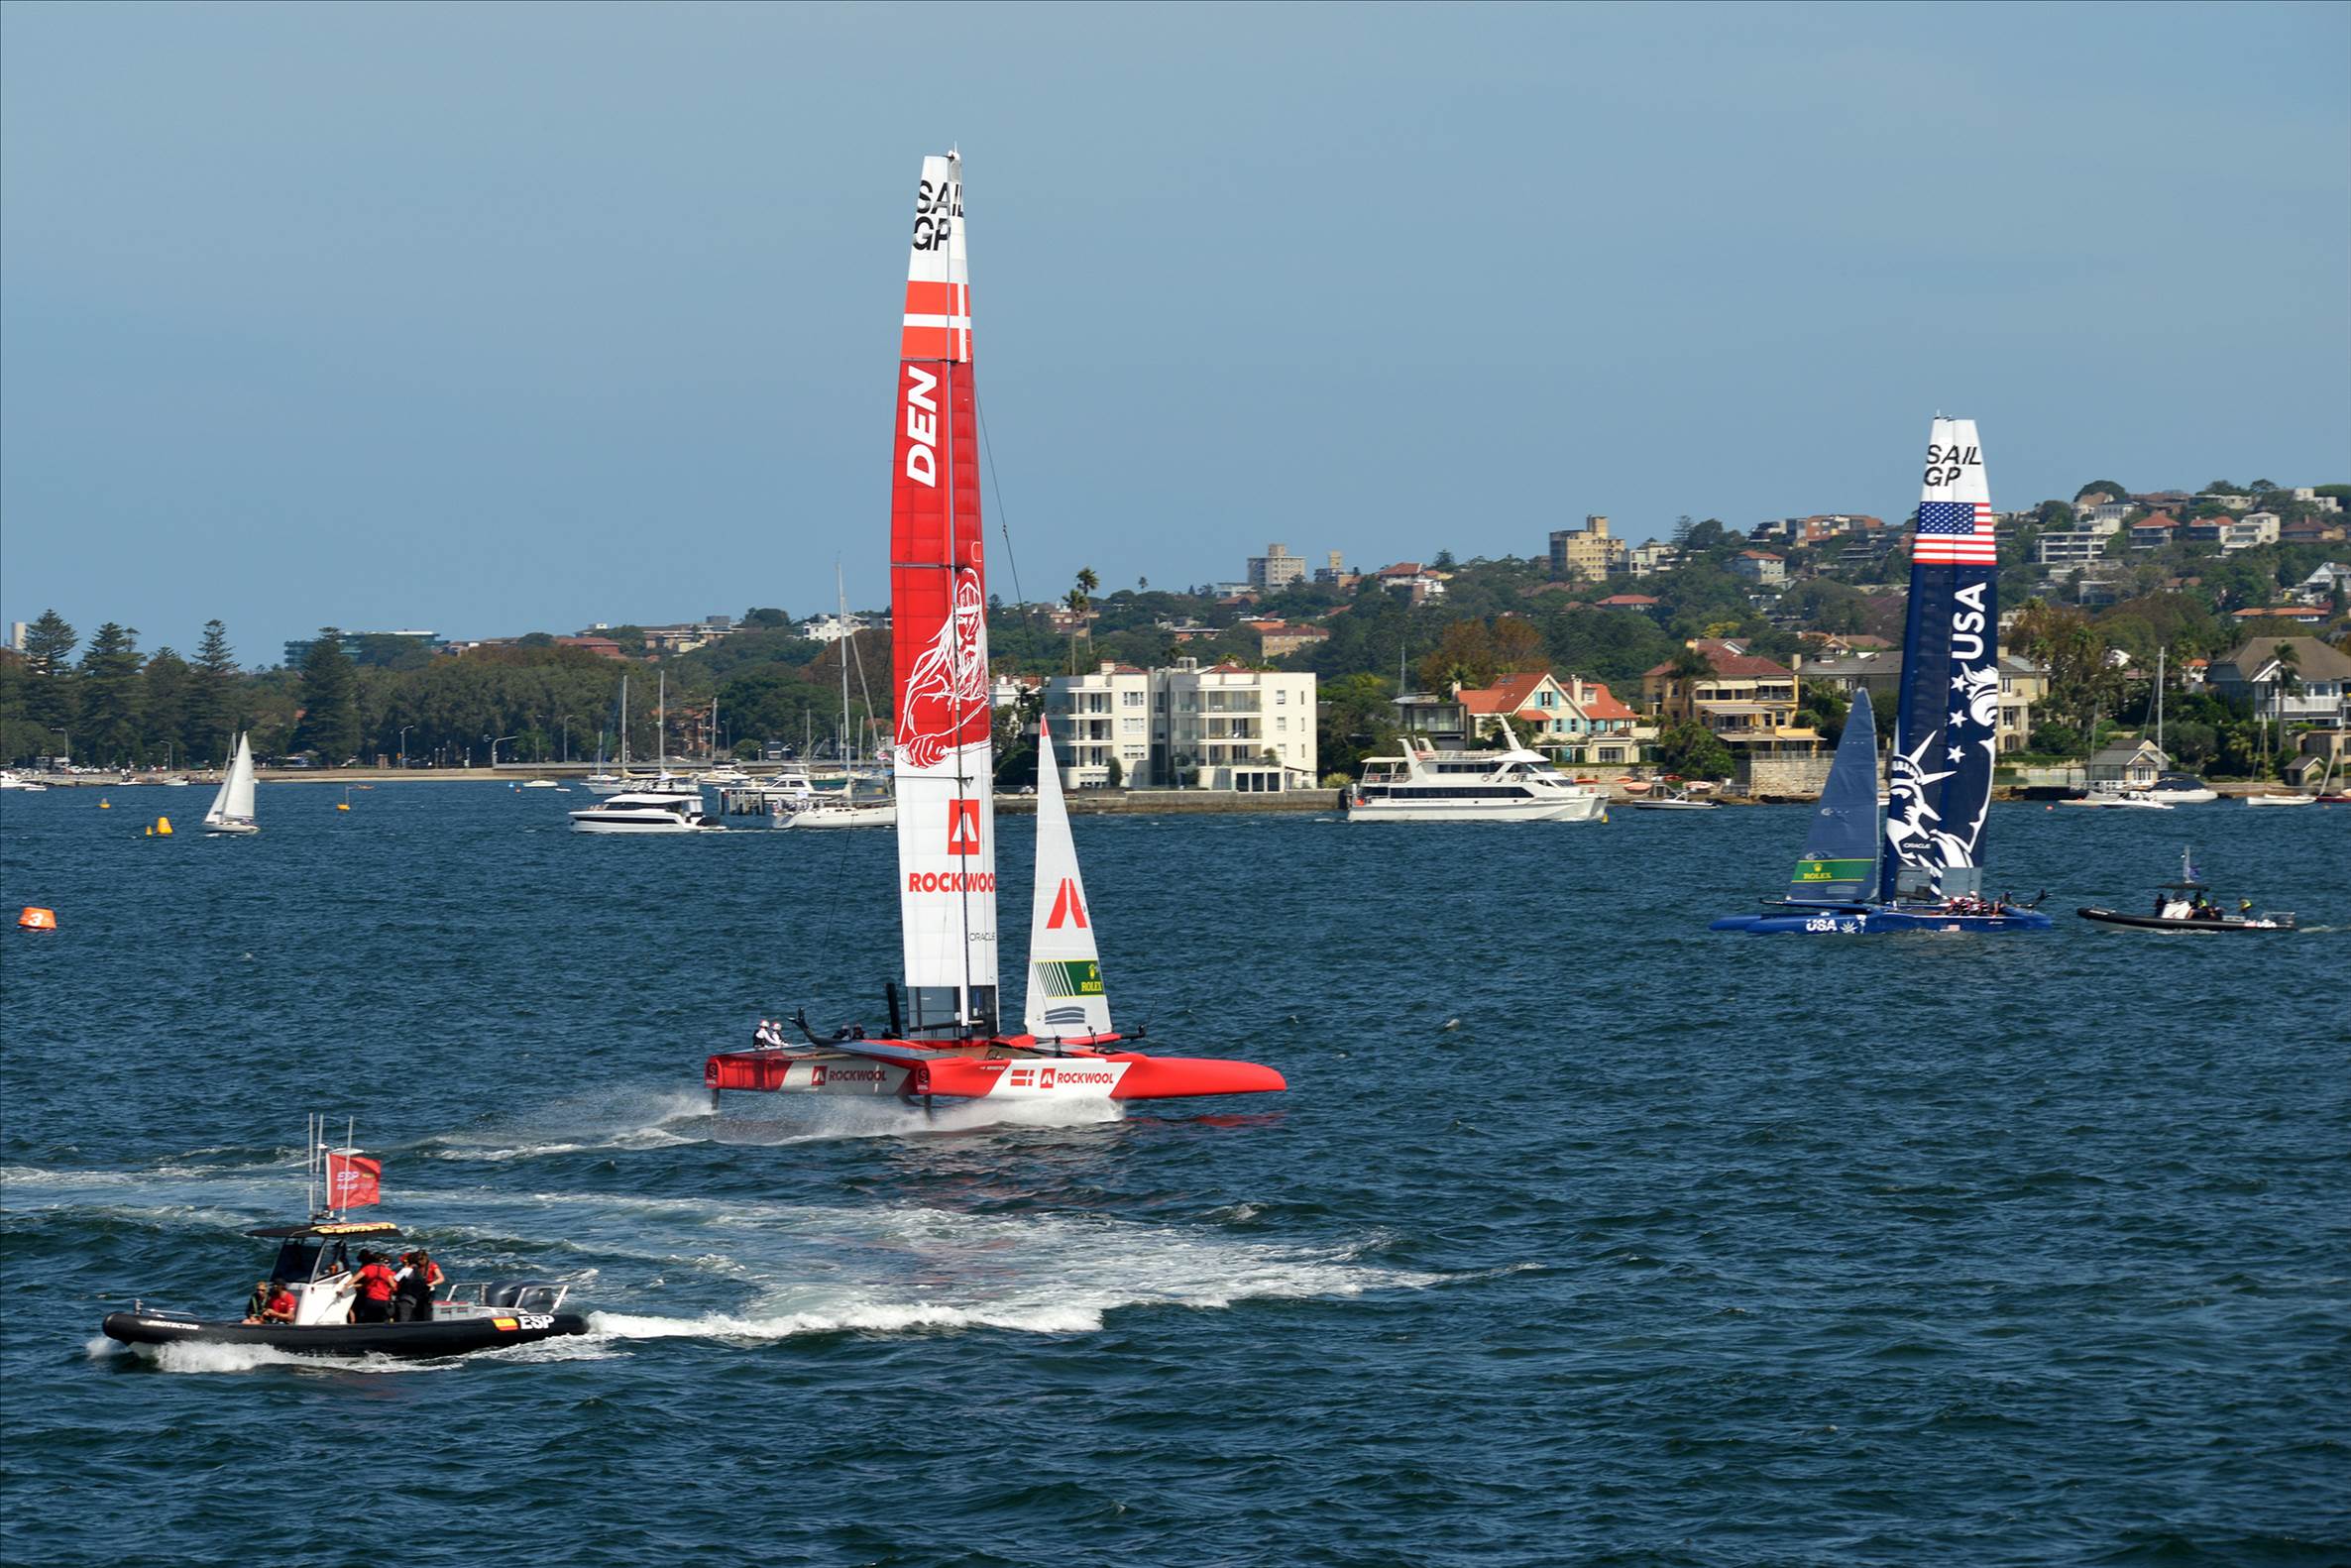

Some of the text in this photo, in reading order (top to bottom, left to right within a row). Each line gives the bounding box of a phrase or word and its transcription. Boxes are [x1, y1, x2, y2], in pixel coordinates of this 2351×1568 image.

[917, 179, 964, 217] SAIL
[912, 216, 952, 251] GP
[907, 365, 937, 488] DEN
[1926, 444, 1981, 465] SAIL
[1924, 466, 1961, 487] GP
[1952, 582, 1987, 660] USA
[28, 913, 44, 927] 3
[1806, 919, 1838, 932] USA
[969, 932, 996, 942] ORACLE
[1081, 981, 1102, 991] ROLEX
[830, 1070, 887, 1081] ROCKWOOL
[1058, 1072, 1113, 1084] ROCKWOOL
[517, 1314, 555, 1330] ESP
